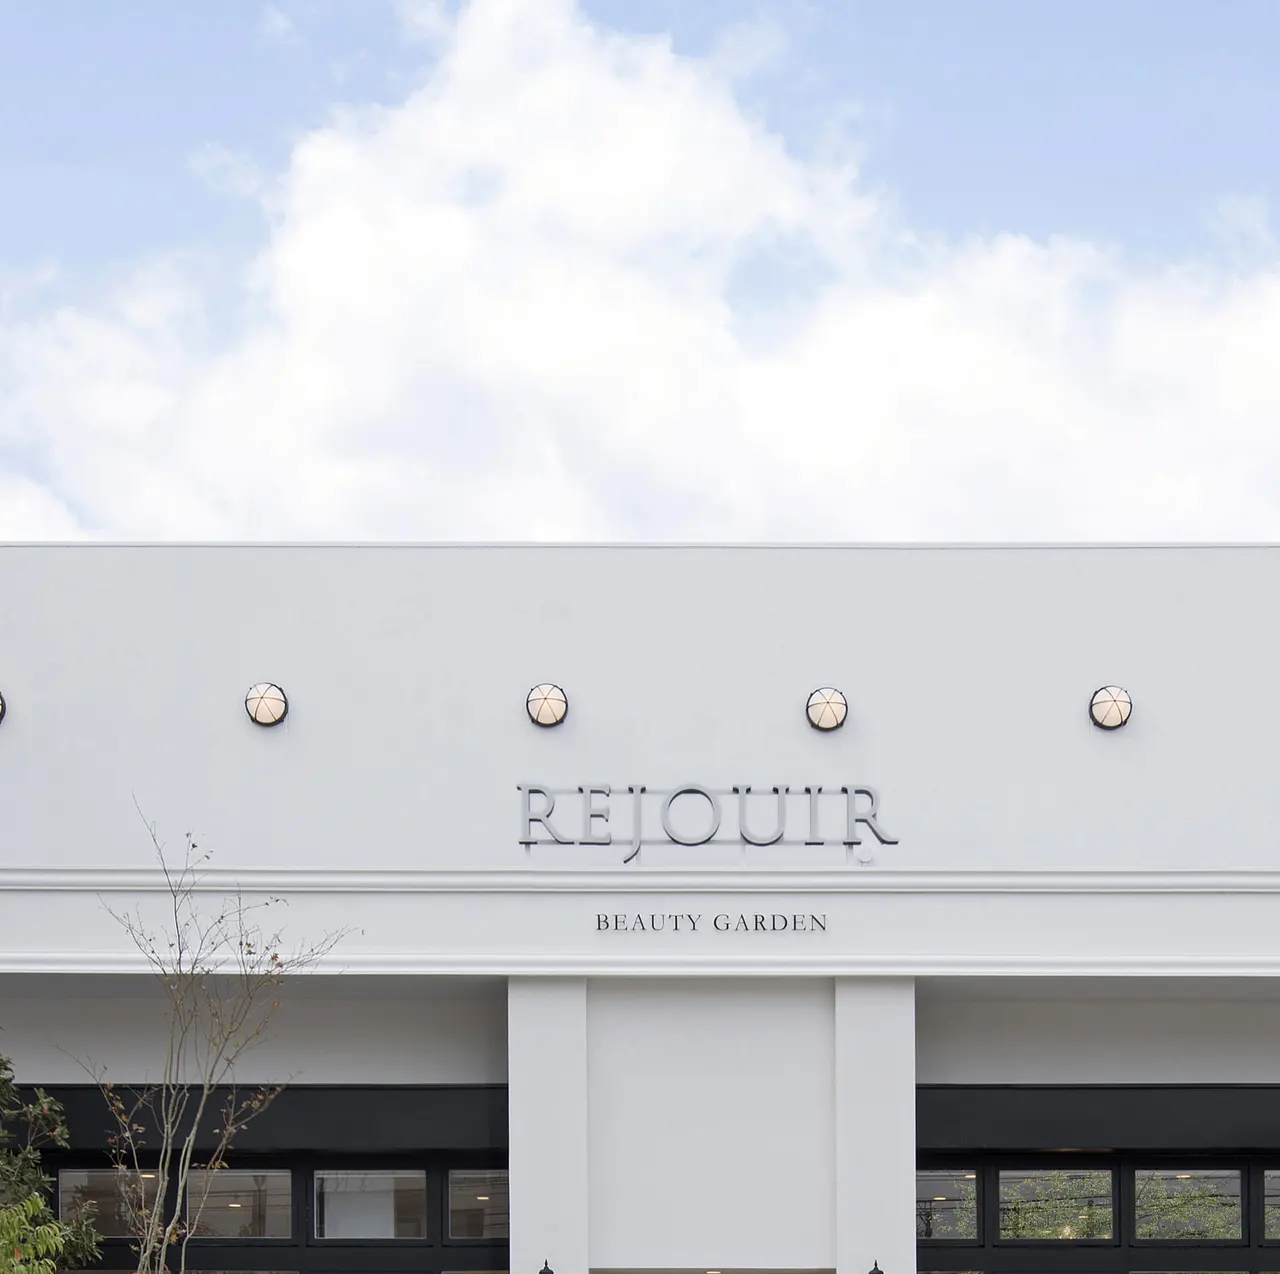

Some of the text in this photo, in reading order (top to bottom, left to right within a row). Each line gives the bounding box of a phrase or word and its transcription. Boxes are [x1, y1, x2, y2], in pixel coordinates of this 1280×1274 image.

[517, 783, 900, 864] REJOUIR
[595, 913, 828, 932] BEAUTY GARDEN
